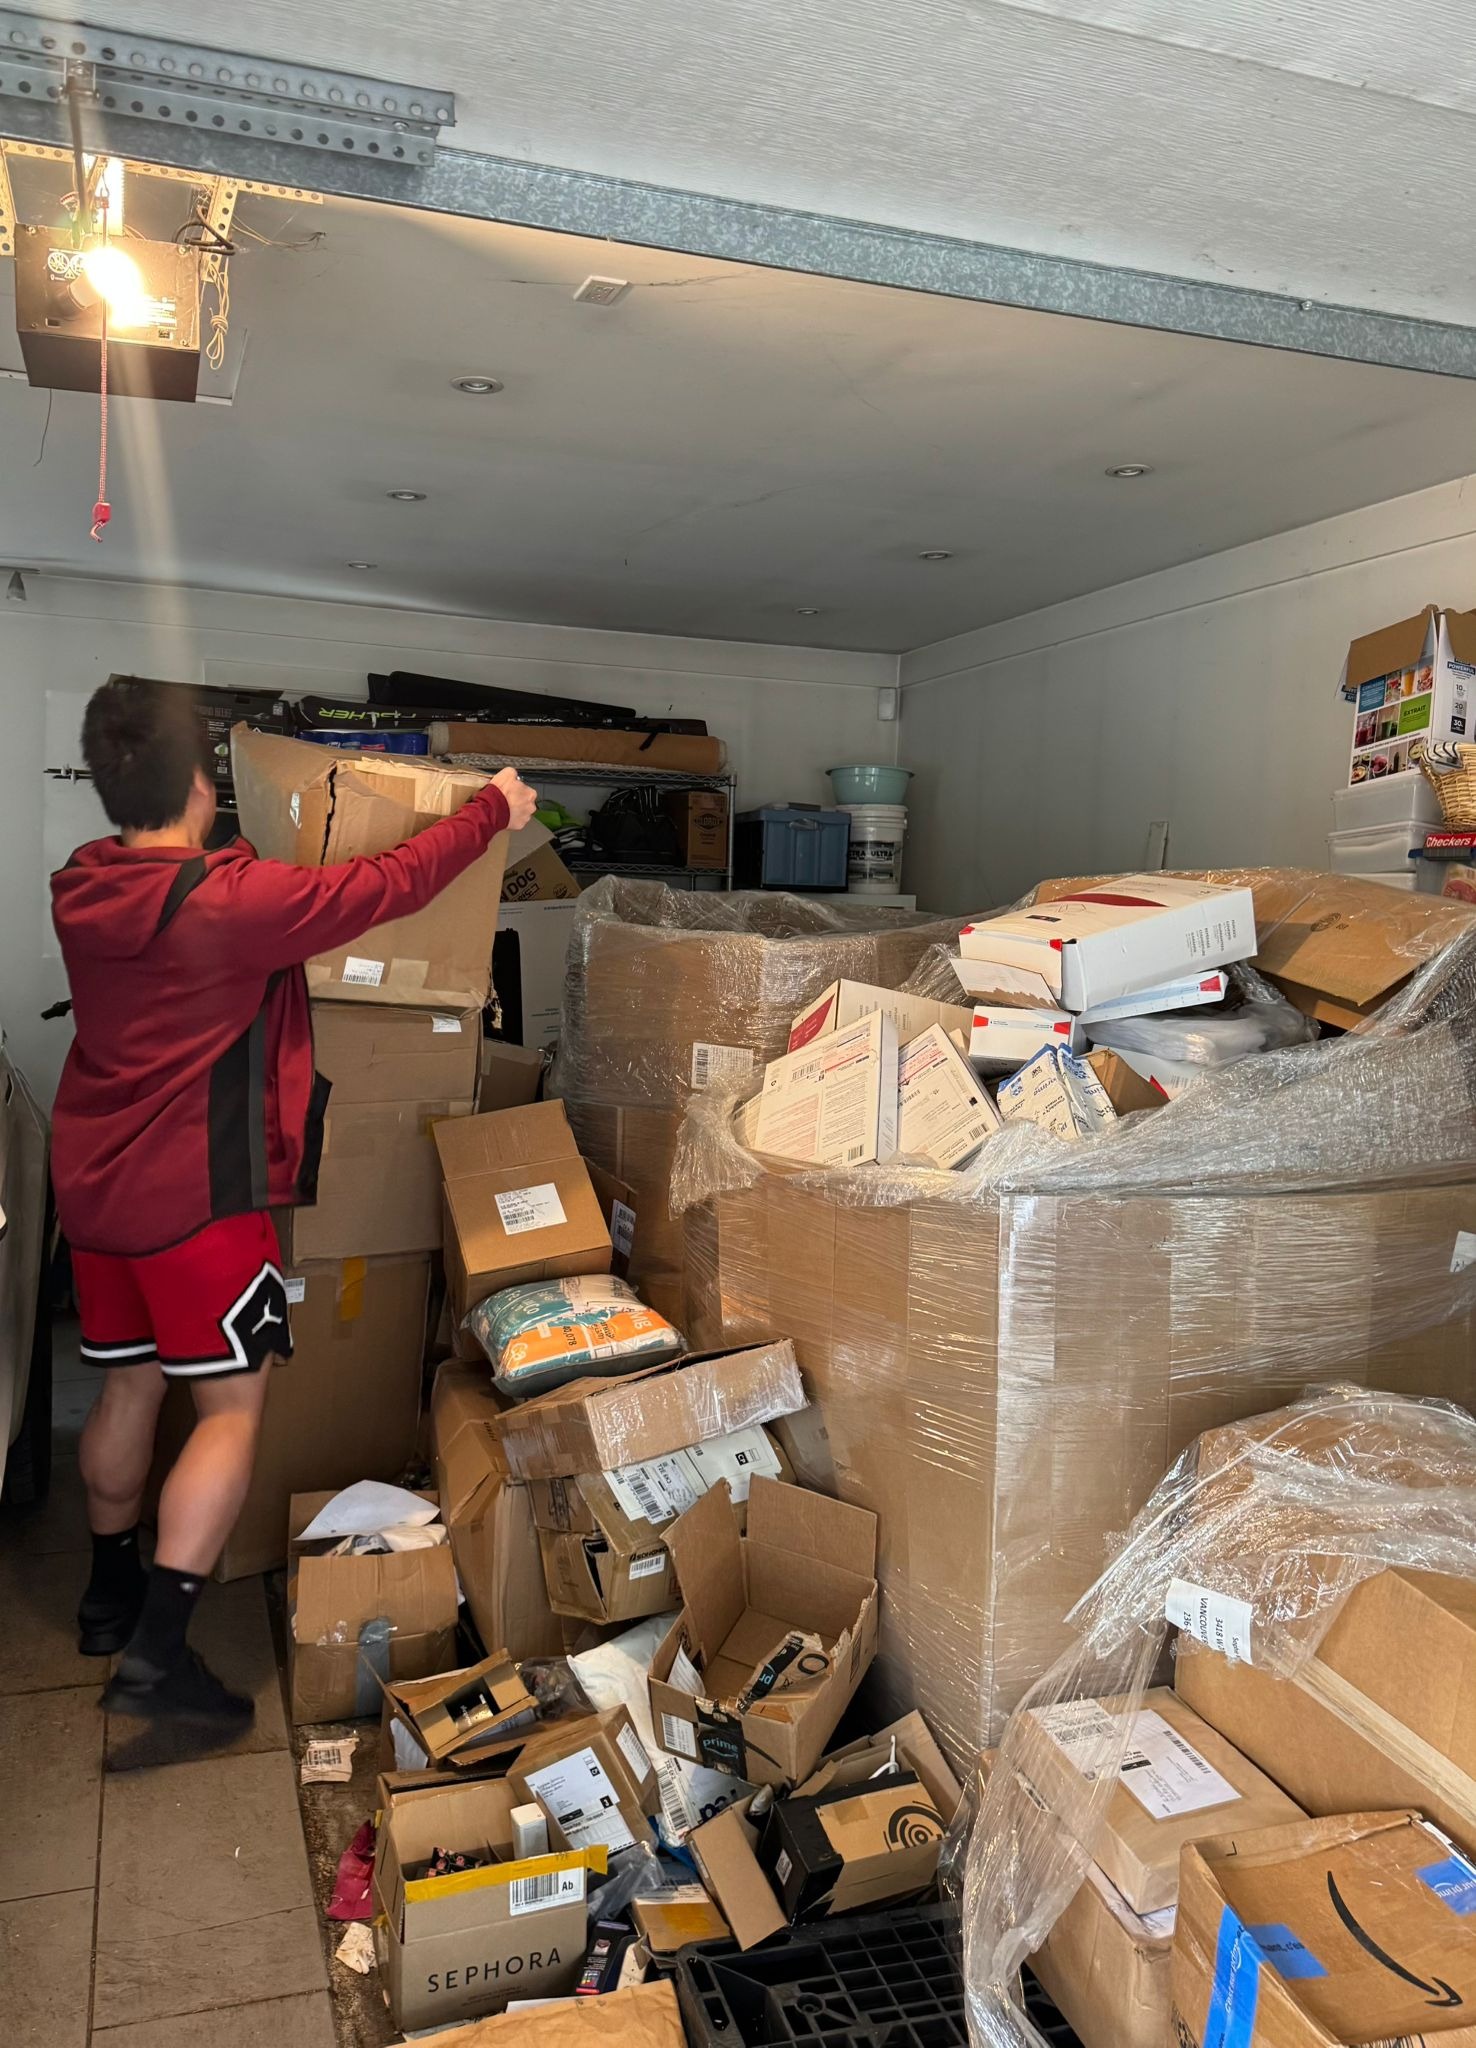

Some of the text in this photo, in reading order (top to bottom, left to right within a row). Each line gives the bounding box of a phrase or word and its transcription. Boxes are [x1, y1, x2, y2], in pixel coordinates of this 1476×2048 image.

[1426, 835, 1471, 848] Checkers
[507, 867, 537, 897] DOG
[629, 1311, 653, 1330] Mg
[563, 1325, 578, 1346] 40,078
[1200, 1598, 1209, 1644] VANCOUVER
[1215, 1618, 1223, 1637] 3418
[702, 1737, 738, 1752] prime
[561, 1880, 574, 1892] Ab
[428, 1947, 561, 1993] SEPHORA
